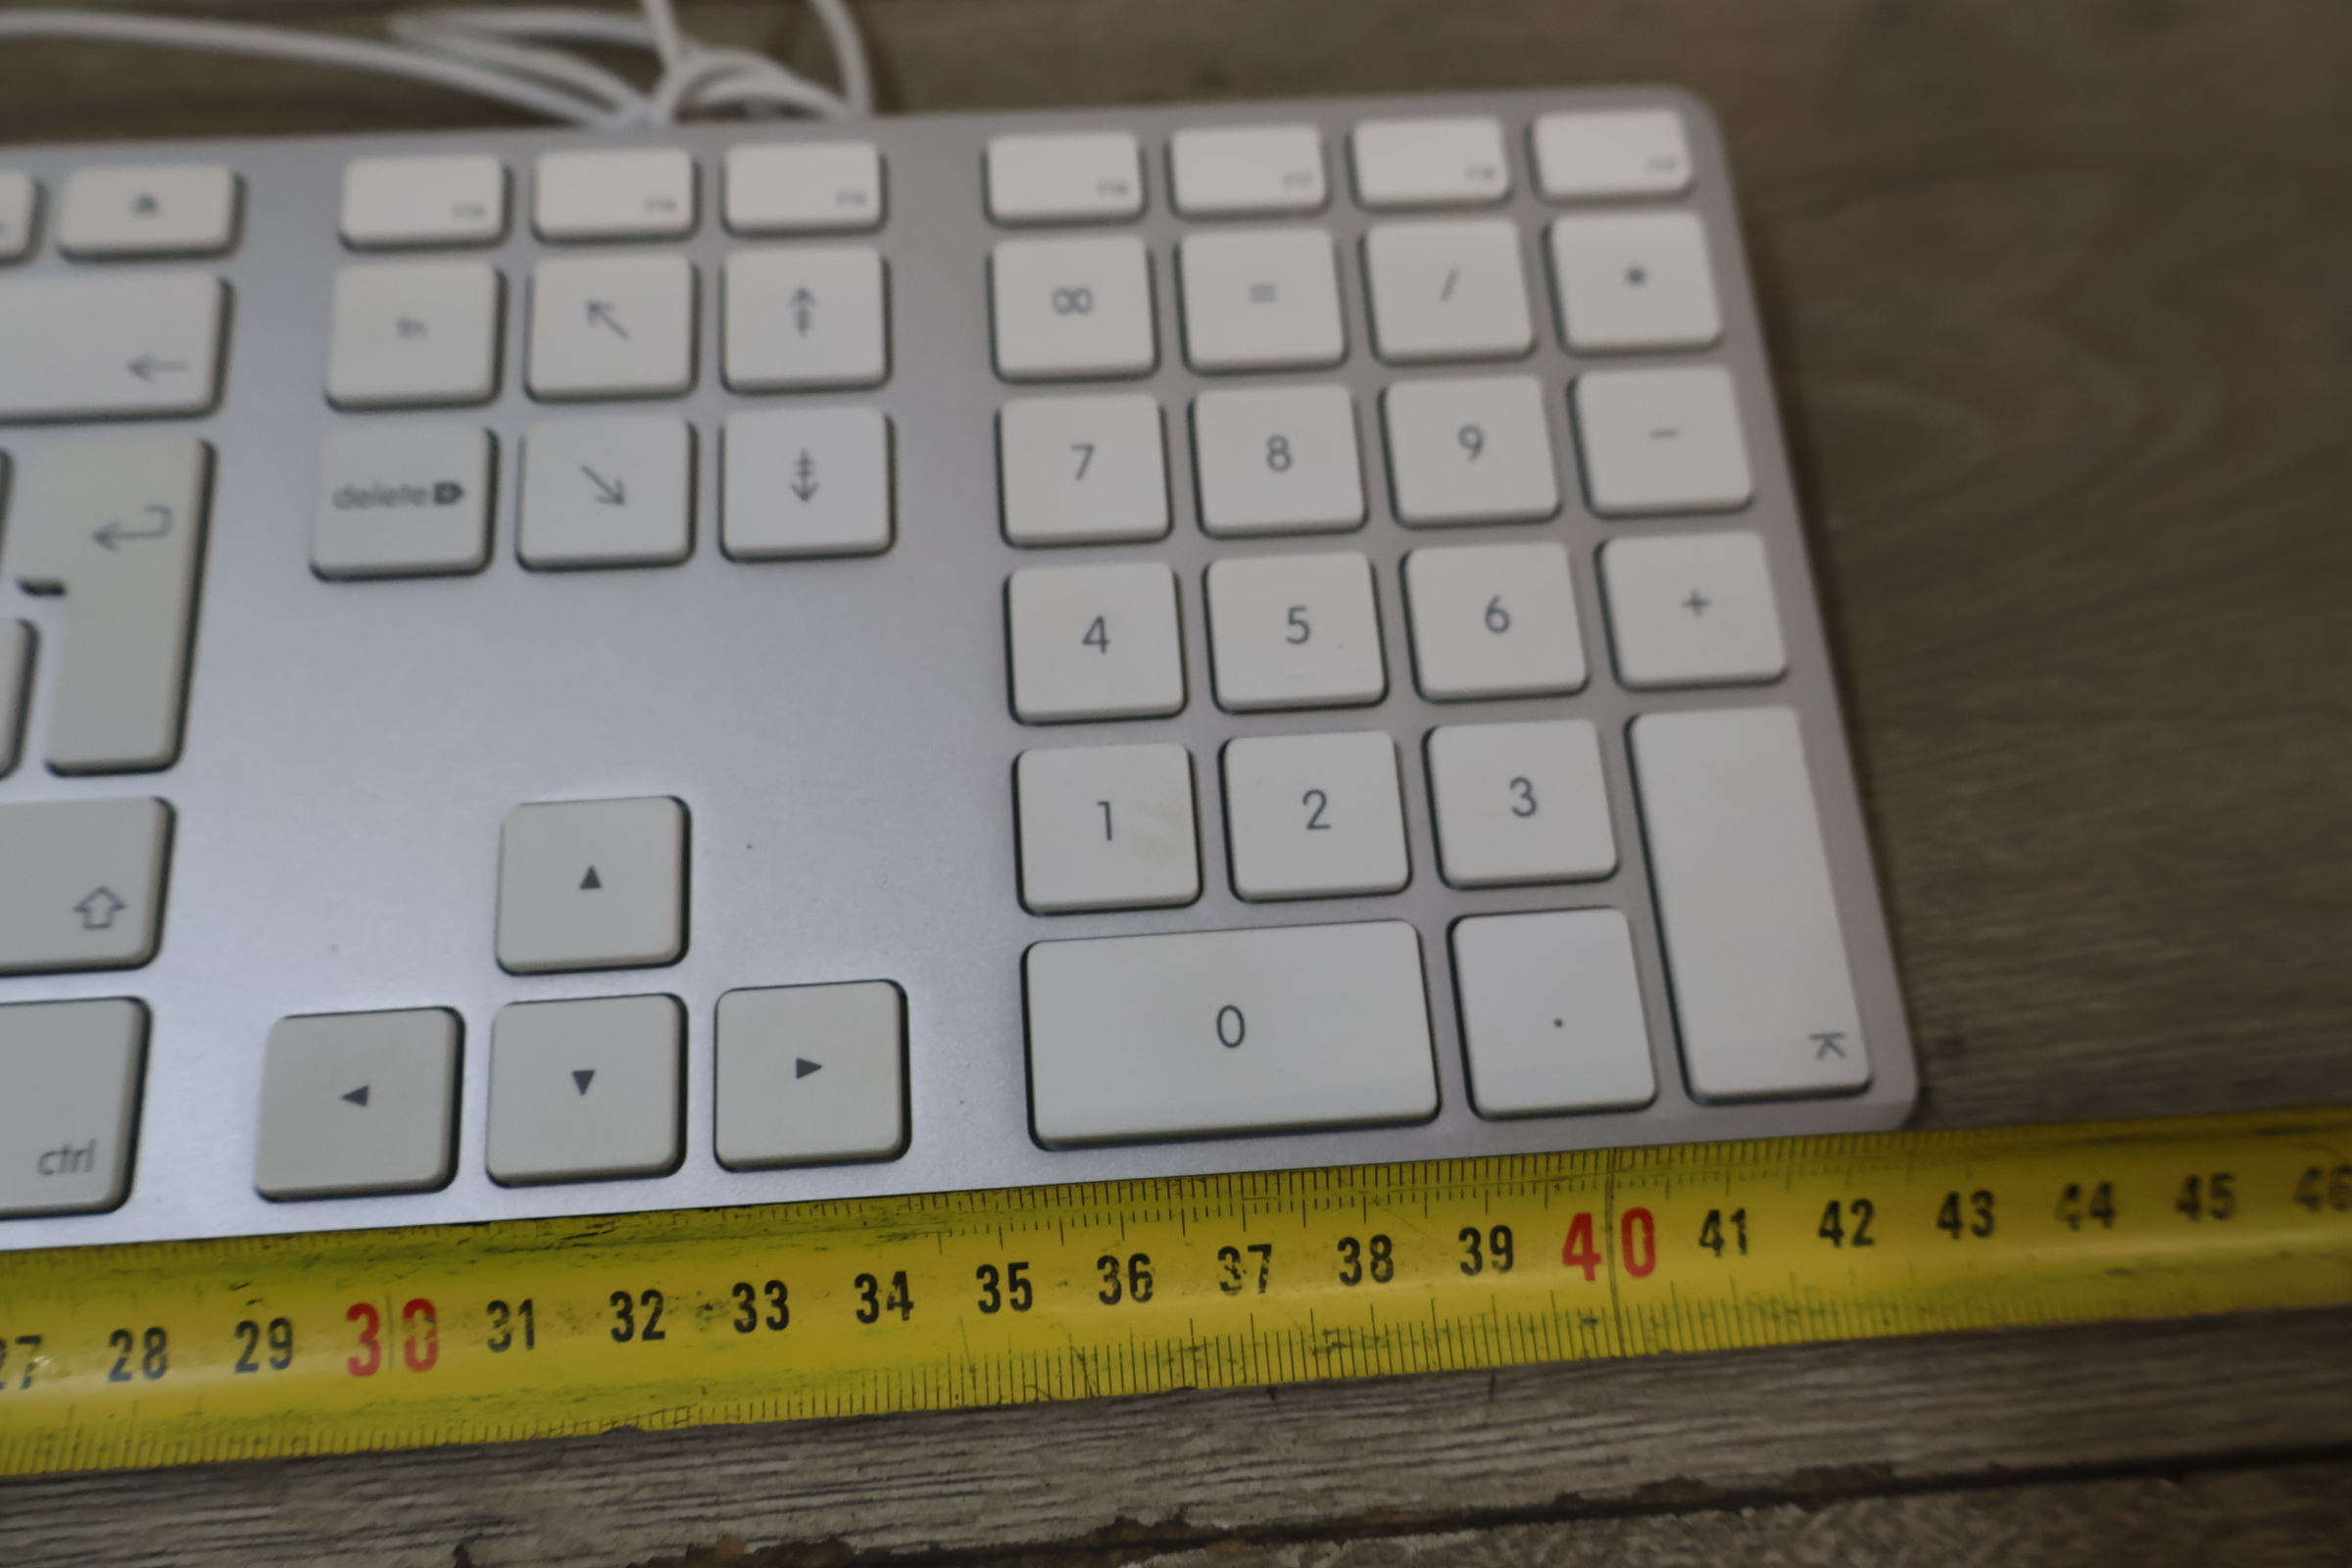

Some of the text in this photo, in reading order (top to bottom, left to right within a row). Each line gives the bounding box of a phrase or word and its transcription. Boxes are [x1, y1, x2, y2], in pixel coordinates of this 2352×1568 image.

[1070, 442, 1097, 482] 7
[1265, 433, 1295, 473] 8
[1456, 424, 1486, 461] 9
[332, 482, 429, 511] delete
[1081, 615, 1110, 655] 4
[1285, 605, 1312, 647] 5
[1483, 595, 1512, 635] 6
[1301, 787, 1332, 832] 2
[1509, 775, 1540, 819] 3
[1096, 799, 1115, 843] 1
[1215, 1003, 1248, 1051] 0
[37, 1139, 97, 1177] ctrl
[108, 1326, 169, 1383] 28
[234, 1316, 294, 1373] 29
[345, 1298, 440, 1378] 30
[485, 1298, 536, 1352] 31
[609, 1289, 666, 1344] 32
[730, 1279, 791, 1335] 33
[853, 1270, 915, 1325] 34
[974, 1261, 1034, 1315] 35
[1096, 1252, 1154, 1306] 36
[1216, 1243, 1274, 1297] 37
[1336, 1234, 1395, 1287] 38
[1457, 1224, 1515, 1276] 39
[1561, 1205, 1658, 1283] 40
[1698, 1206, 1750, 1258] 41
[1818, 1198, 1876, 1249] 42
[1936, 1189, 1995, 1240] 43
[2057, 1181, 2117, 1231] 44
[2174, 1172, 2236, 1223] 45
[2293, 1163, 2352, 1213] 46
